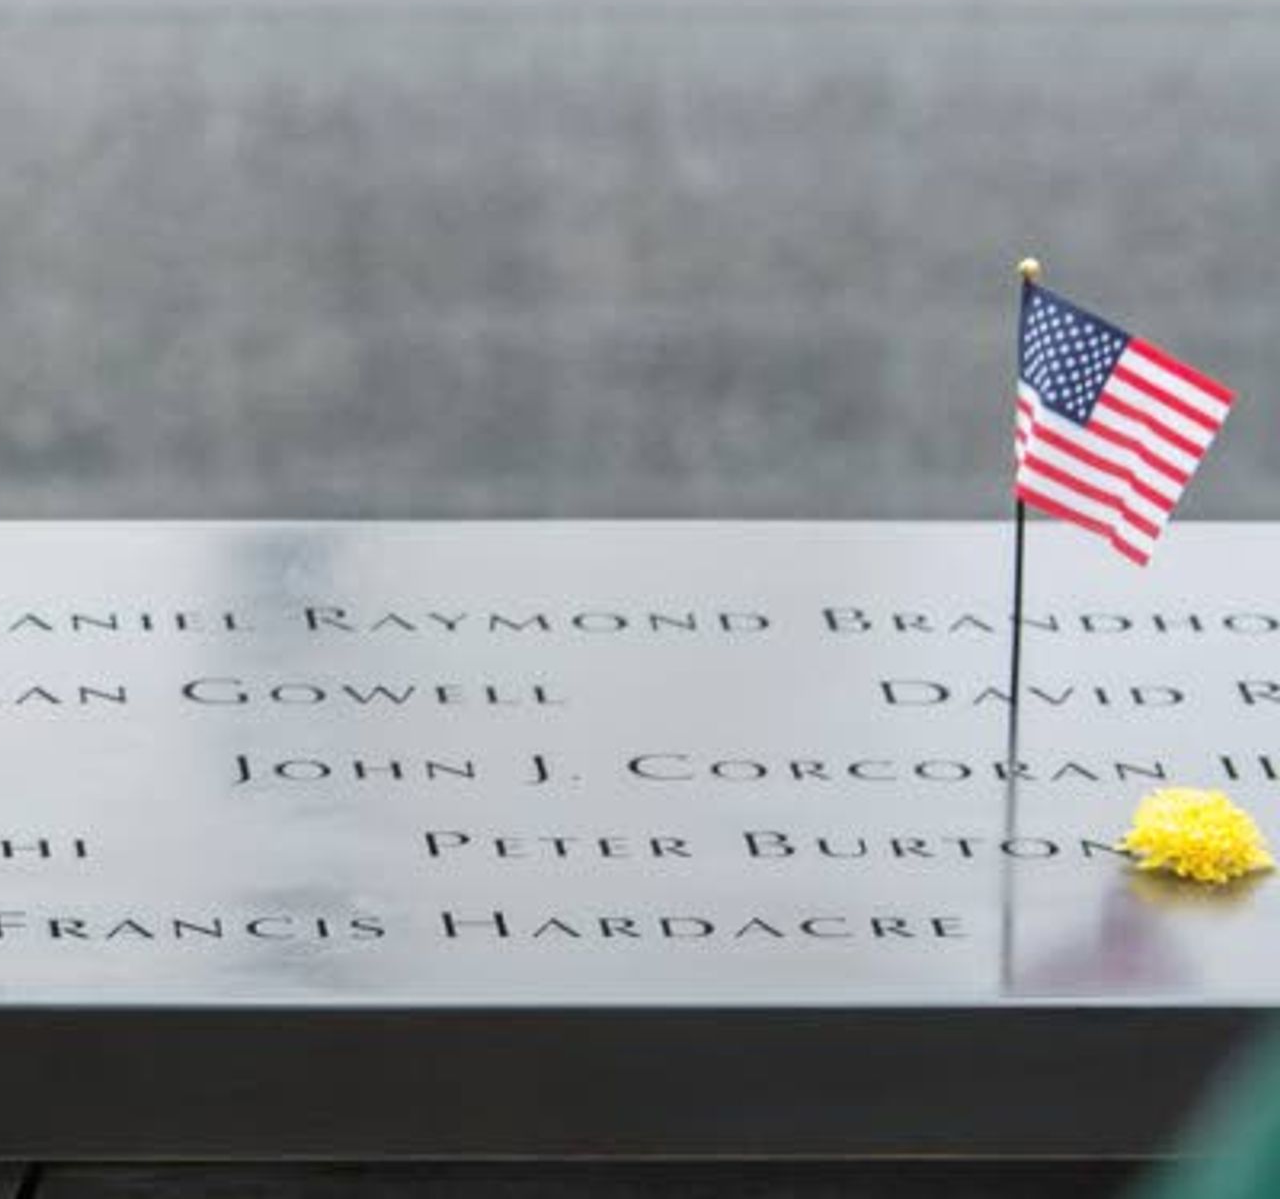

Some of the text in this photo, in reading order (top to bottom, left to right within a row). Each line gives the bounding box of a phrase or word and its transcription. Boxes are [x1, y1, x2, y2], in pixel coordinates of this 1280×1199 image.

[304, 606, 772, 634] RAYMOND
[823, 607, 1280, 634] BRANDHO
[180, 678, 566, 706] GOWELL
[879, 680, 1186, 707] DAVID
[232, 754, 478, 784] JOHN
[528, 754, 582, 784] J.
[626, 753, 1168, 782] CORCORAN
[424, 831, 1140, 860] PETER BURTON
[441, 910, 970, 940] HARDACRE
